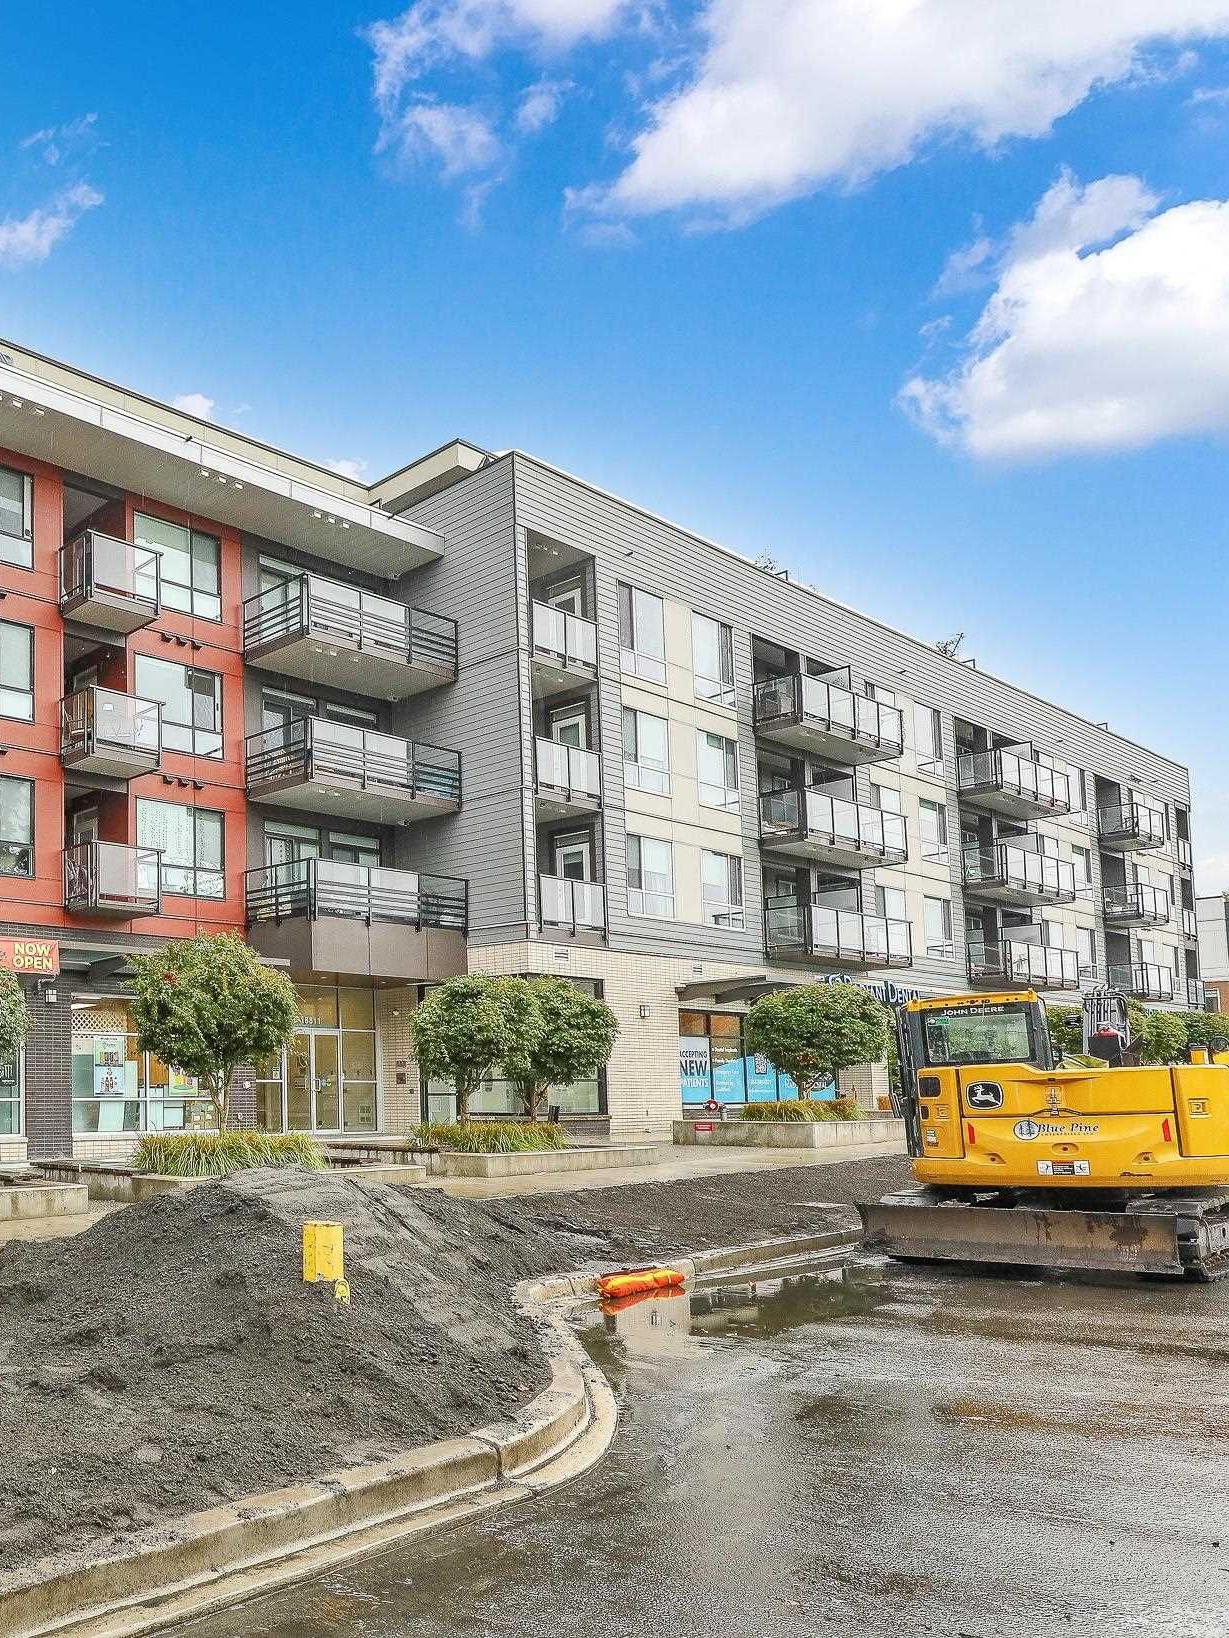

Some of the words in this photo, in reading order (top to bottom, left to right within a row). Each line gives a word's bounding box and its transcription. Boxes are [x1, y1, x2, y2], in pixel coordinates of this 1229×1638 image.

[14, 942, 51, 957] NOW
[12, 955, 53, 970] OPEN
[941, 1008, 968, 1016] JOHN
[970, 1006, 1005, 1014] DEERE
[680, 1060, 708, 1077] NEW
[1038, 1123, 1066, 1133] Blue
[1071, 1122, 1099, 1132] Pine
